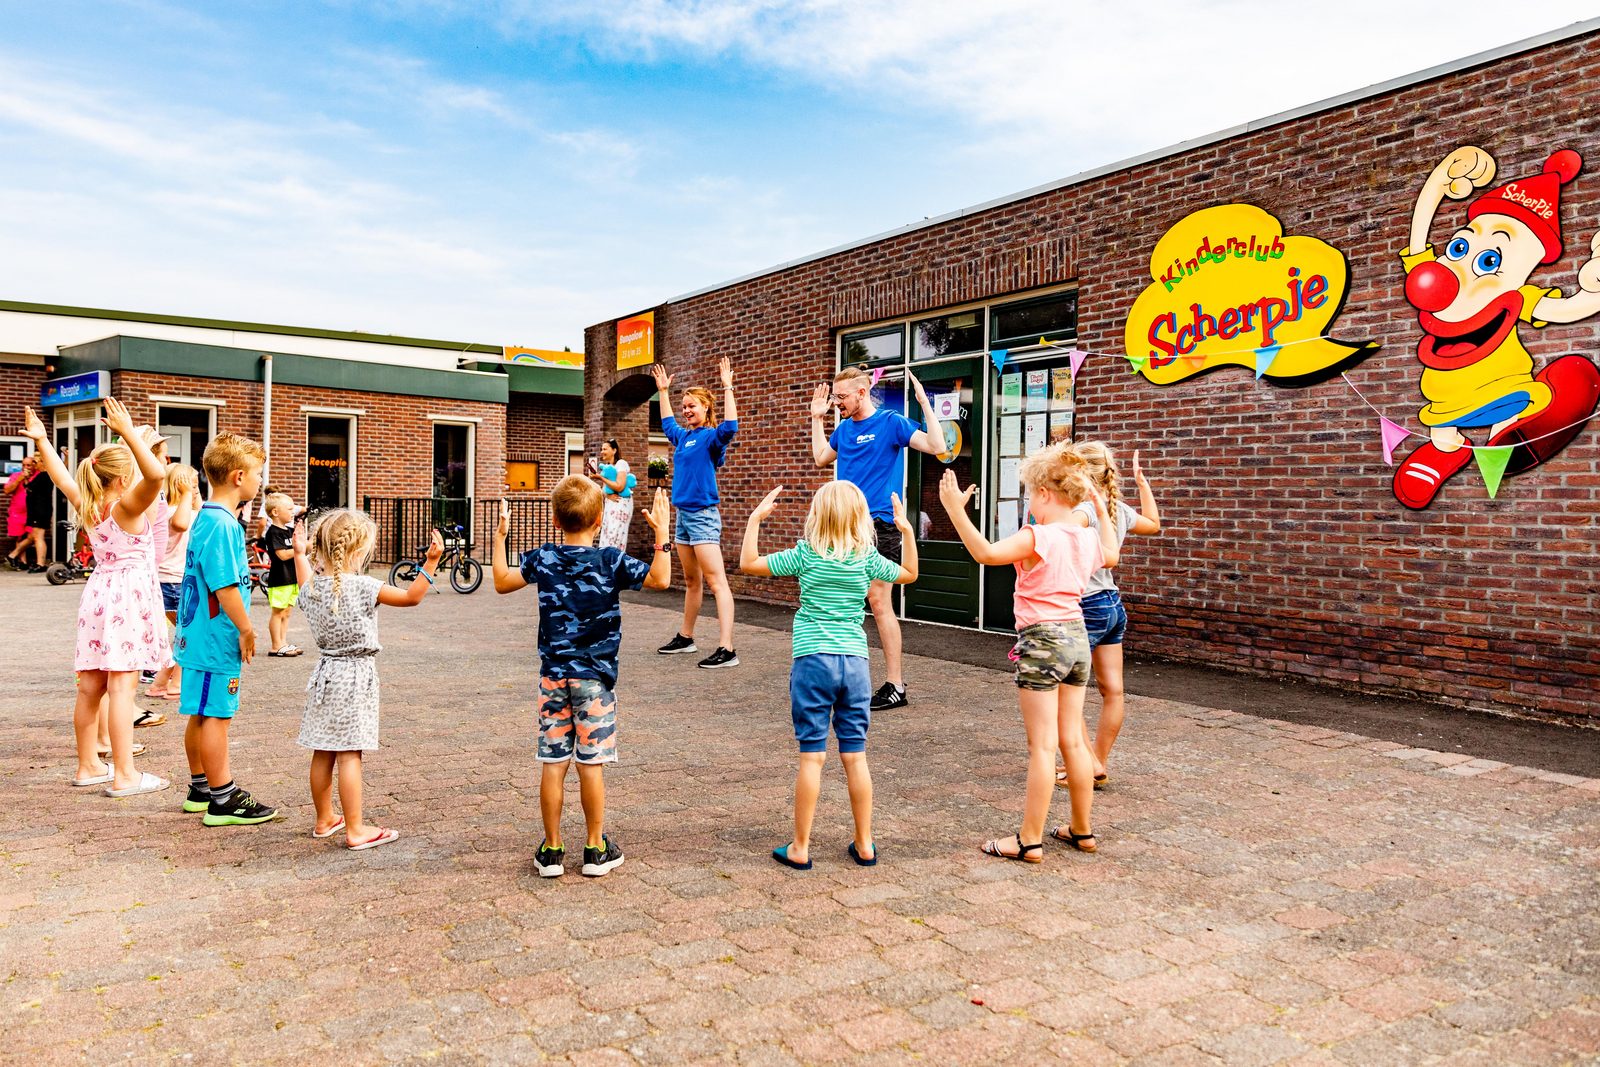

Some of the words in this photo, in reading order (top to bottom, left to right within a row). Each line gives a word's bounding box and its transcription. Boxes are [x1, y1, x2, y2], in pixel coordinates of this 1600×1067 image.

[1160, 235, 1285, 292] Kinderclub
[1148, 267, 1328, 370] Scherpje
[60, 382, 80, 398] Receptie
[309, 456, 347, 468] Receptie
